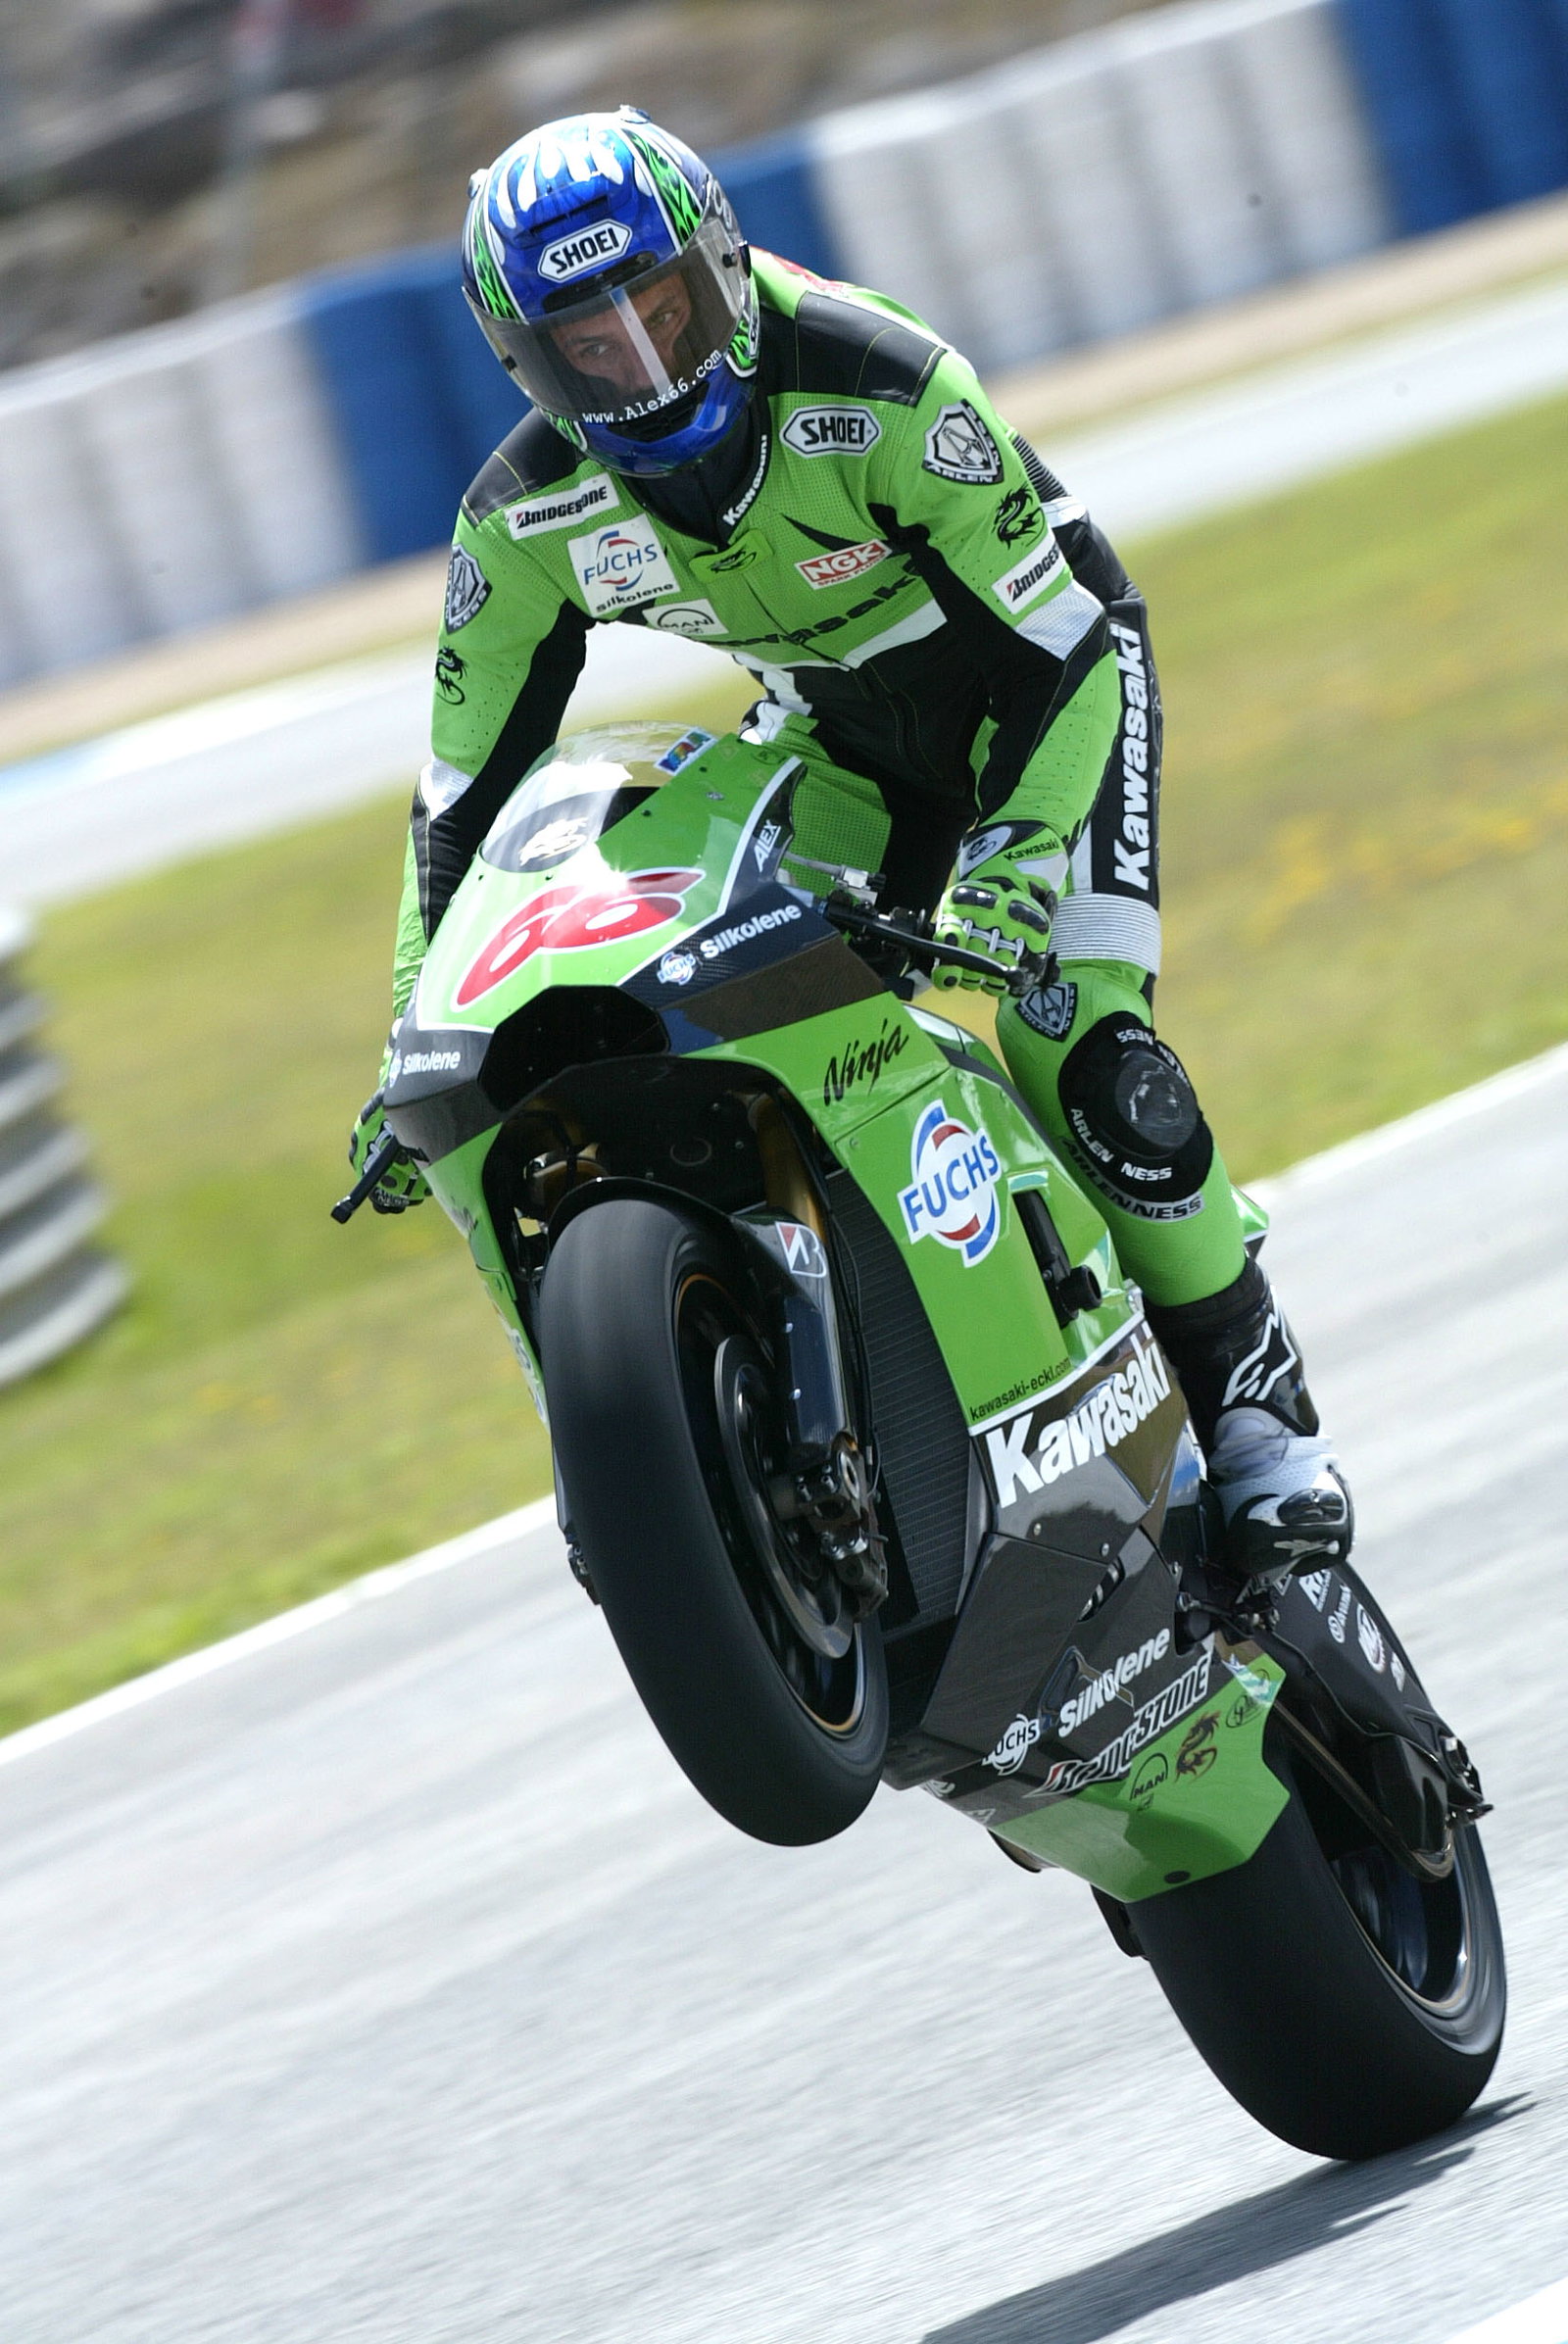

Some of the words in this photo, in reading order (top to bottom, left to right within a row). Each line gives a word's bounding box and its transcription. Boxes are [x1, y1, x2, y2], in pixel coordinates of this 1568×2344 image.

[549, 227, 619, 274] SHOEI
[582, 349, 722, 423] www.Alex66.com
[800, 416, 865, 445] SHOEI
[583, 543, 658, 585] FUCHS
[804, 544, 882, 579] NGK
[1109, 622, 1150, 892] Kawasaki
[754, 819, 782, 872] ALEX
[1004, 838, 1059, 860] Kawasaki
[453, 868, 704, 1010] 66
[824, 1018, 909, 1105] Ninja
[1071, 1108, 1114, 1163] ARLEN
[1121, 1162, 1172, 1181] NESS
[904, 1135, 999, 1233] FUCHS
[969, 1357, 1071, 1421] kawasaki-eckl.com
[985, 1323, 1171, 1507] Kawasaki
[983, 1722, 1040, 1765] UCHS
